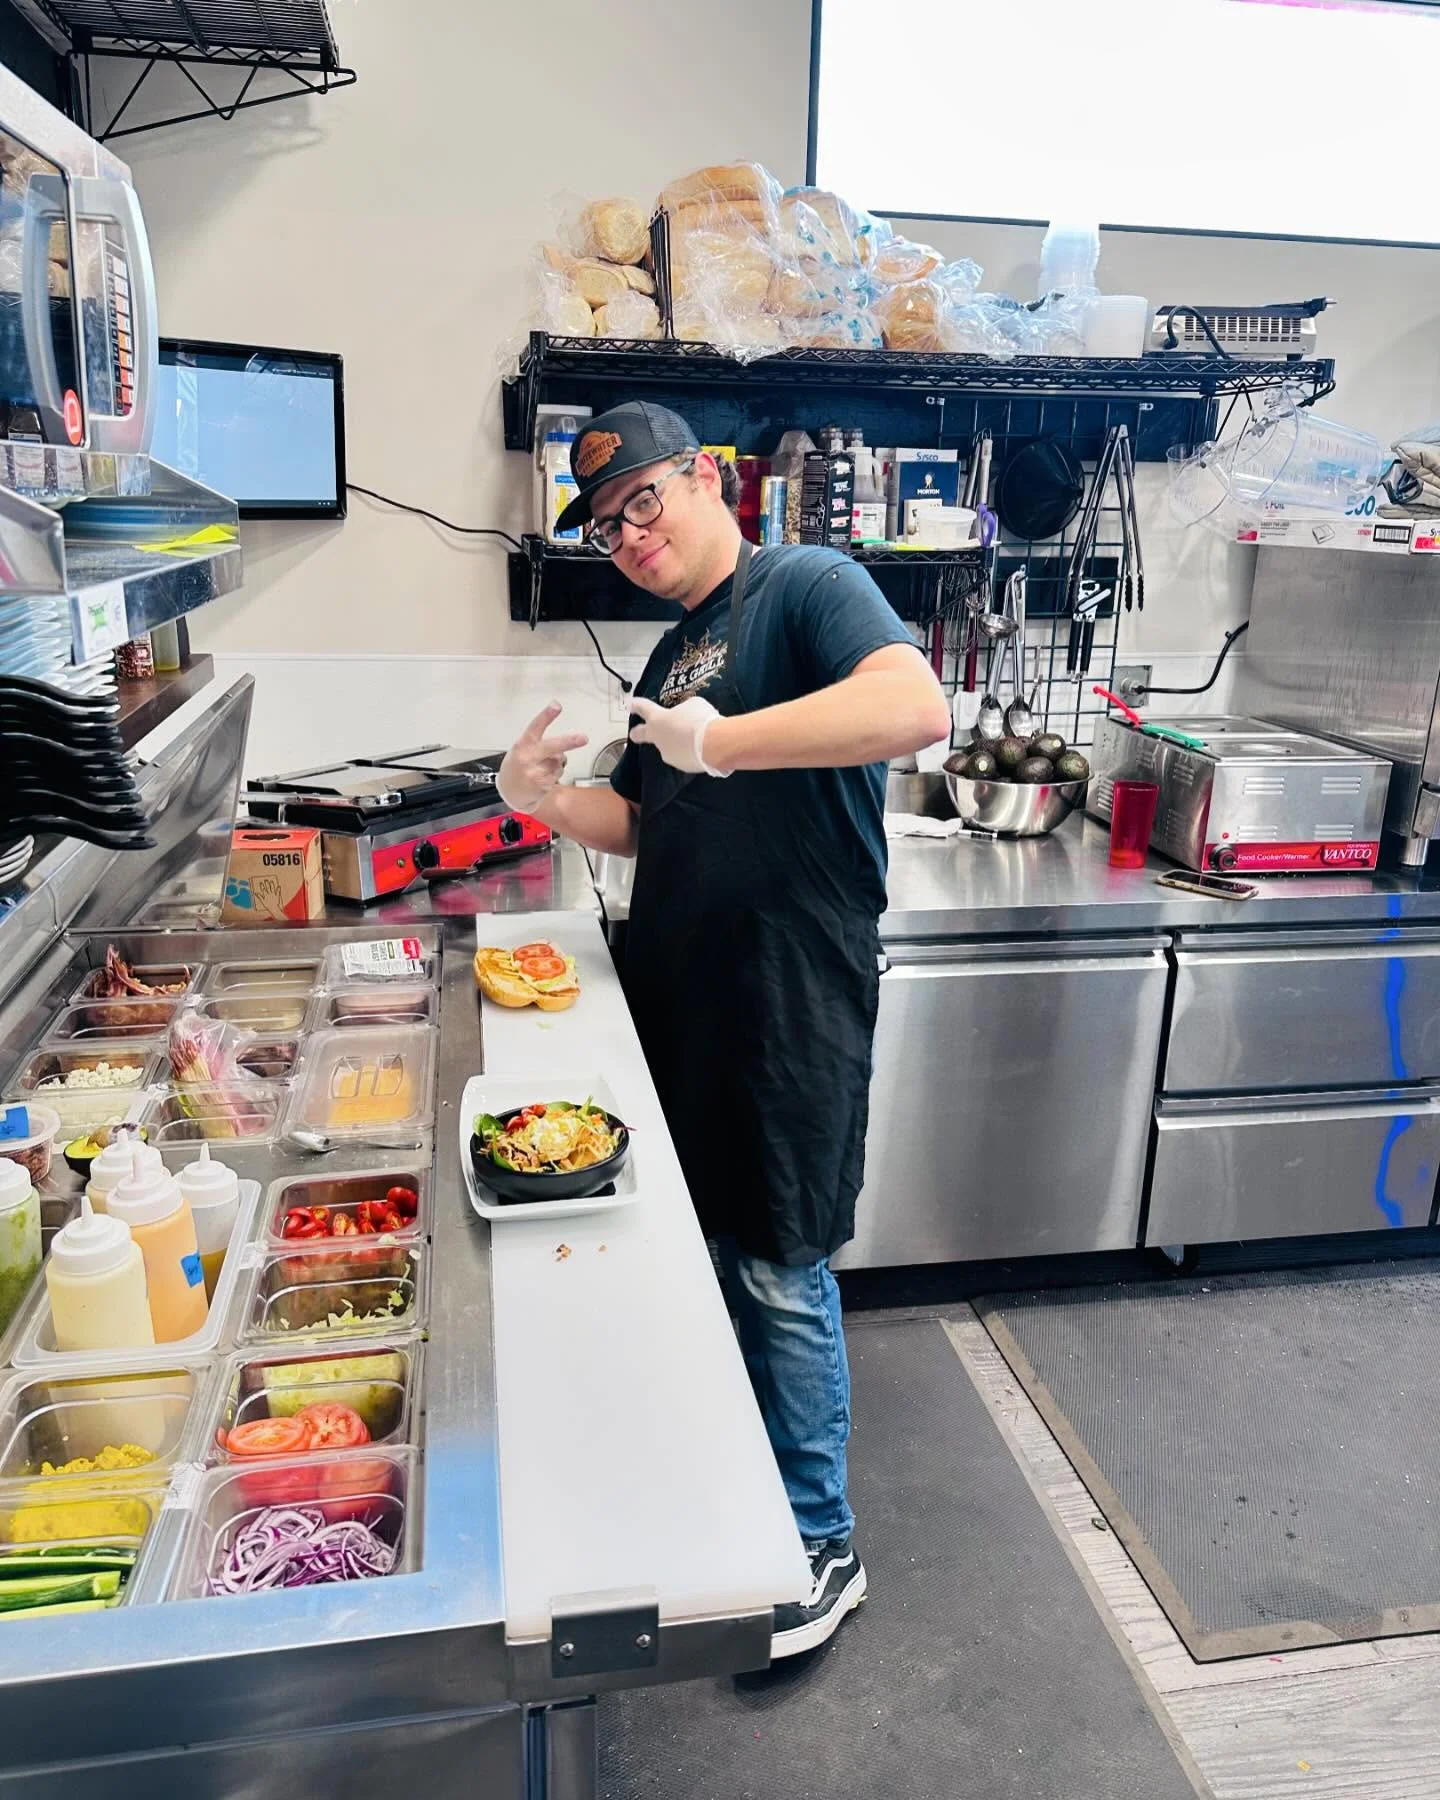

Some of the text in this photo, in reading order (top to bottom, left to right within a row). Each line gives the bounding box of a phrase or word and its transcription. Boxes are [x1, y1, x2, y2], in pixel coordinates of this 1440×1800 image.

[916, 451, 939, 462] Sysco
[690, 654, 725, 681] GRILL
[263, 853, 301, 866] 05816
